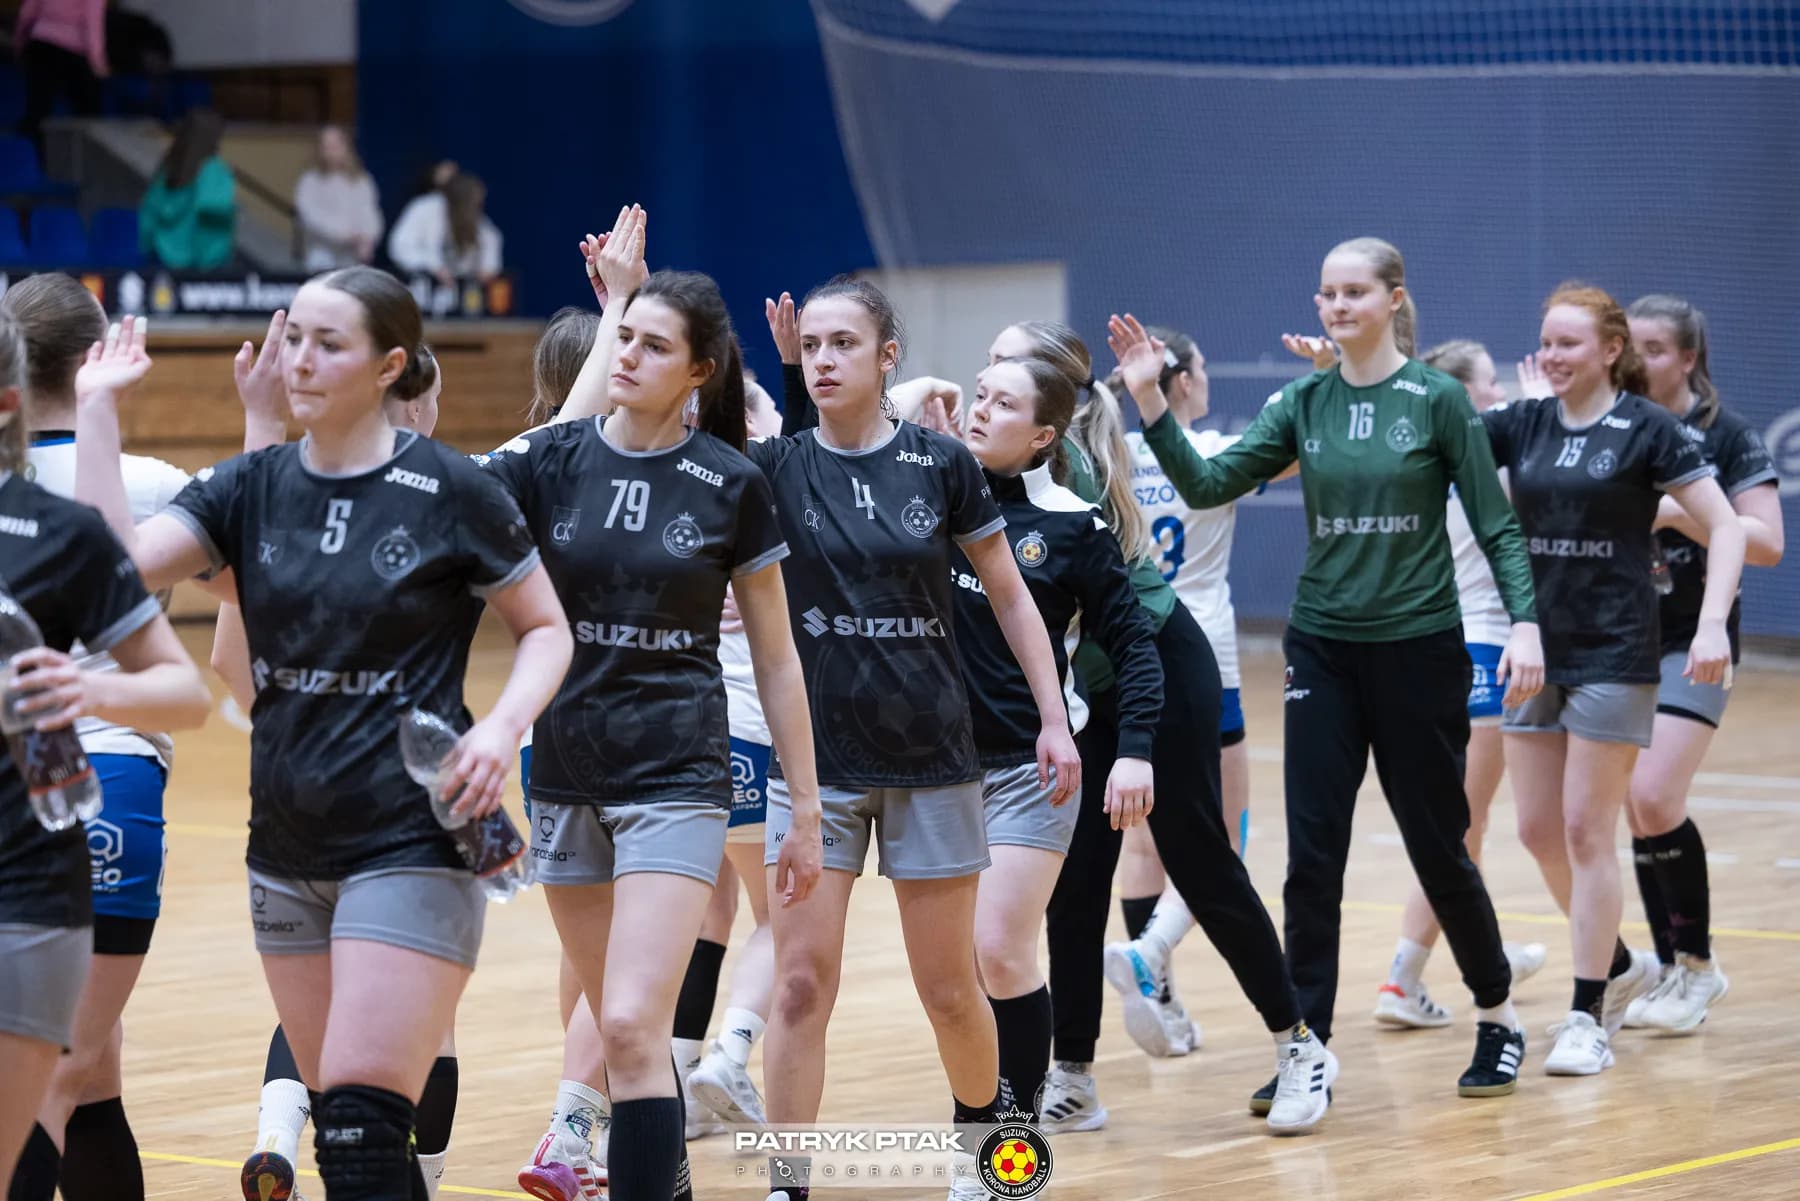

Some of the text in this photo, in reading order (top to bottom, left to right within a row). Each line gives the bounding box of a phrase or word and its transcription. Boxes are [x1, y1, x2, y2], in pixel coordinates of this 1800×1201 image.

[1348, 402, 1374, 440] 16
[1554, 436, 1587, 467] 15
[603, 479, 650, 532] 79
[852, 477, 875, 520] 4
[320, 499, 353, 555] 5
[1333, 515, 1419, 535] SUZUKI
[1530, 537, 1613, 557] SUZUKI
[576, 621, 693, 651] SUZUKI
[274, 667, 405, 696] SUZUKI
